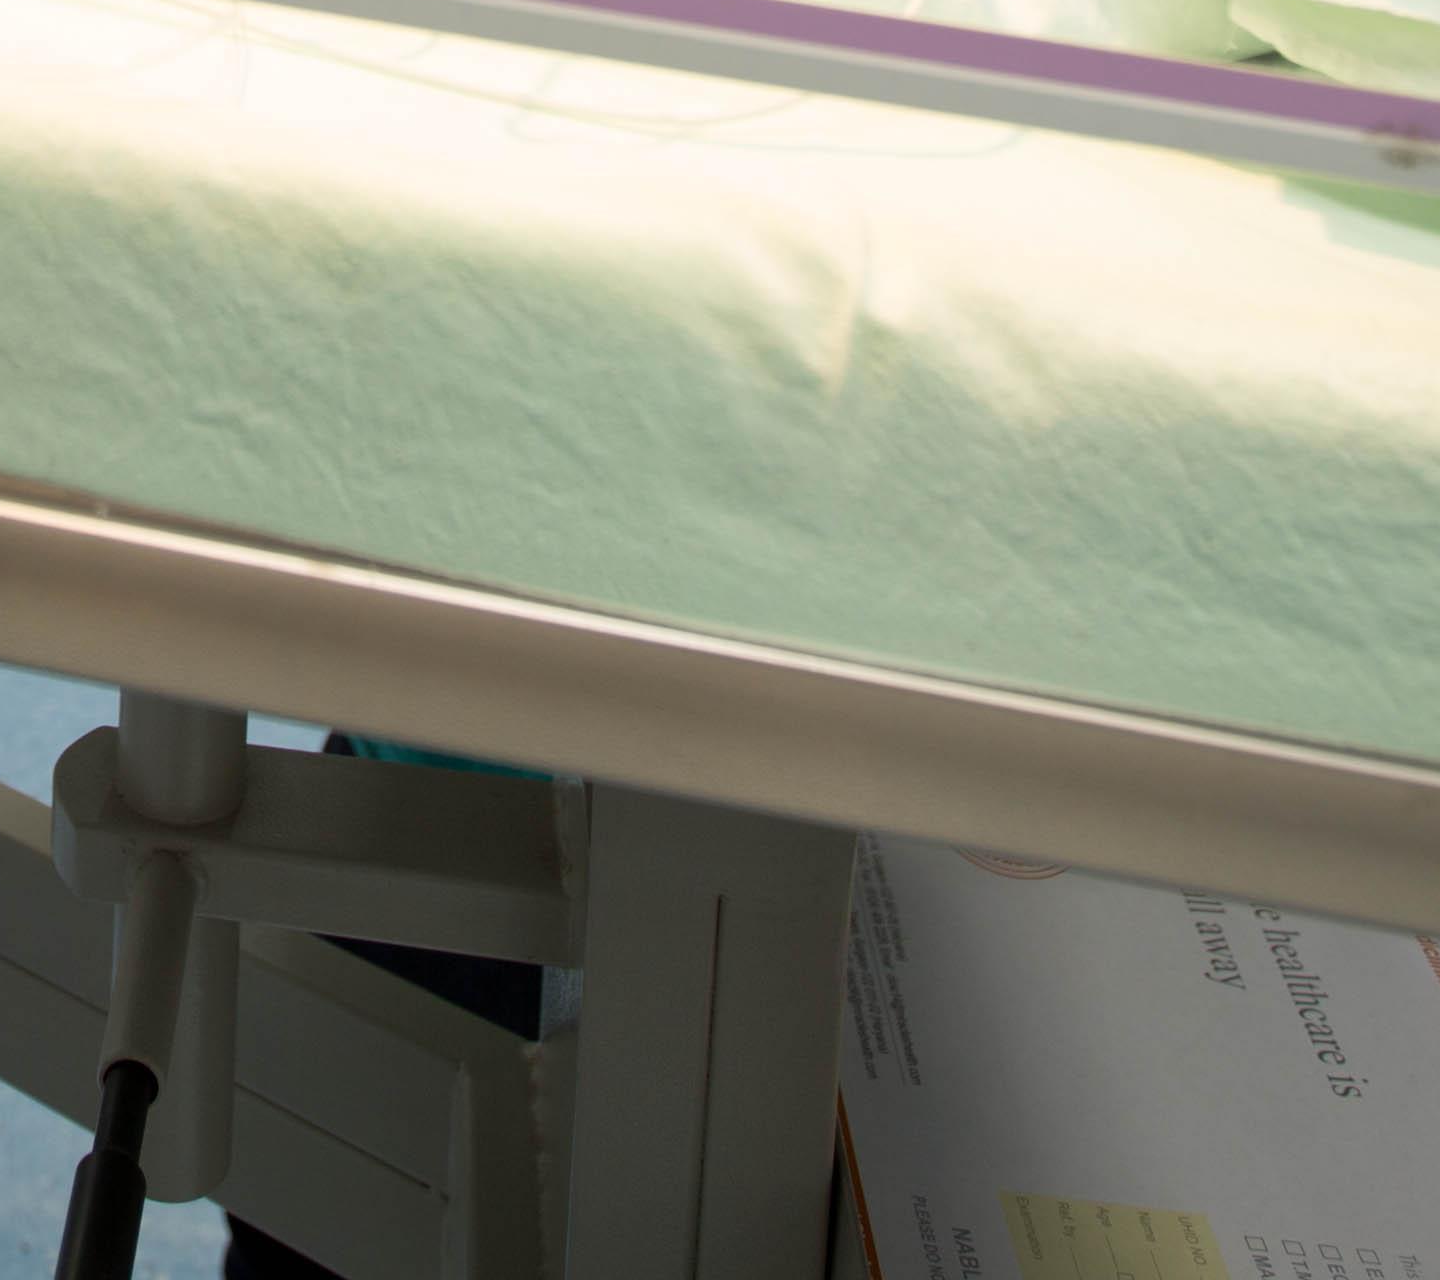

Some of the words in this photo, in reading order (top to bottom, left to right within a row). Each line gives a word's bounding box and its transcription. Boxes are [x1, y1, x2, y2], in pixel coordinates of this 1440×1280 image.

[1196, 921, 1247, 990] away
[1263, 928, 1346, 1065] healthcare
[1326, 1072, 1369, 1099] is
[911, 1194, 937, 1244] PLEASE
[1016, 1193, 1043, 1261] Examination
[1096, 1206, 1113, 1228] Age
[1136, 1210, 1156, 1243] Name
[923, 1243, 941, 1264] DO
[951, 1226, 983, 1280] NABL
